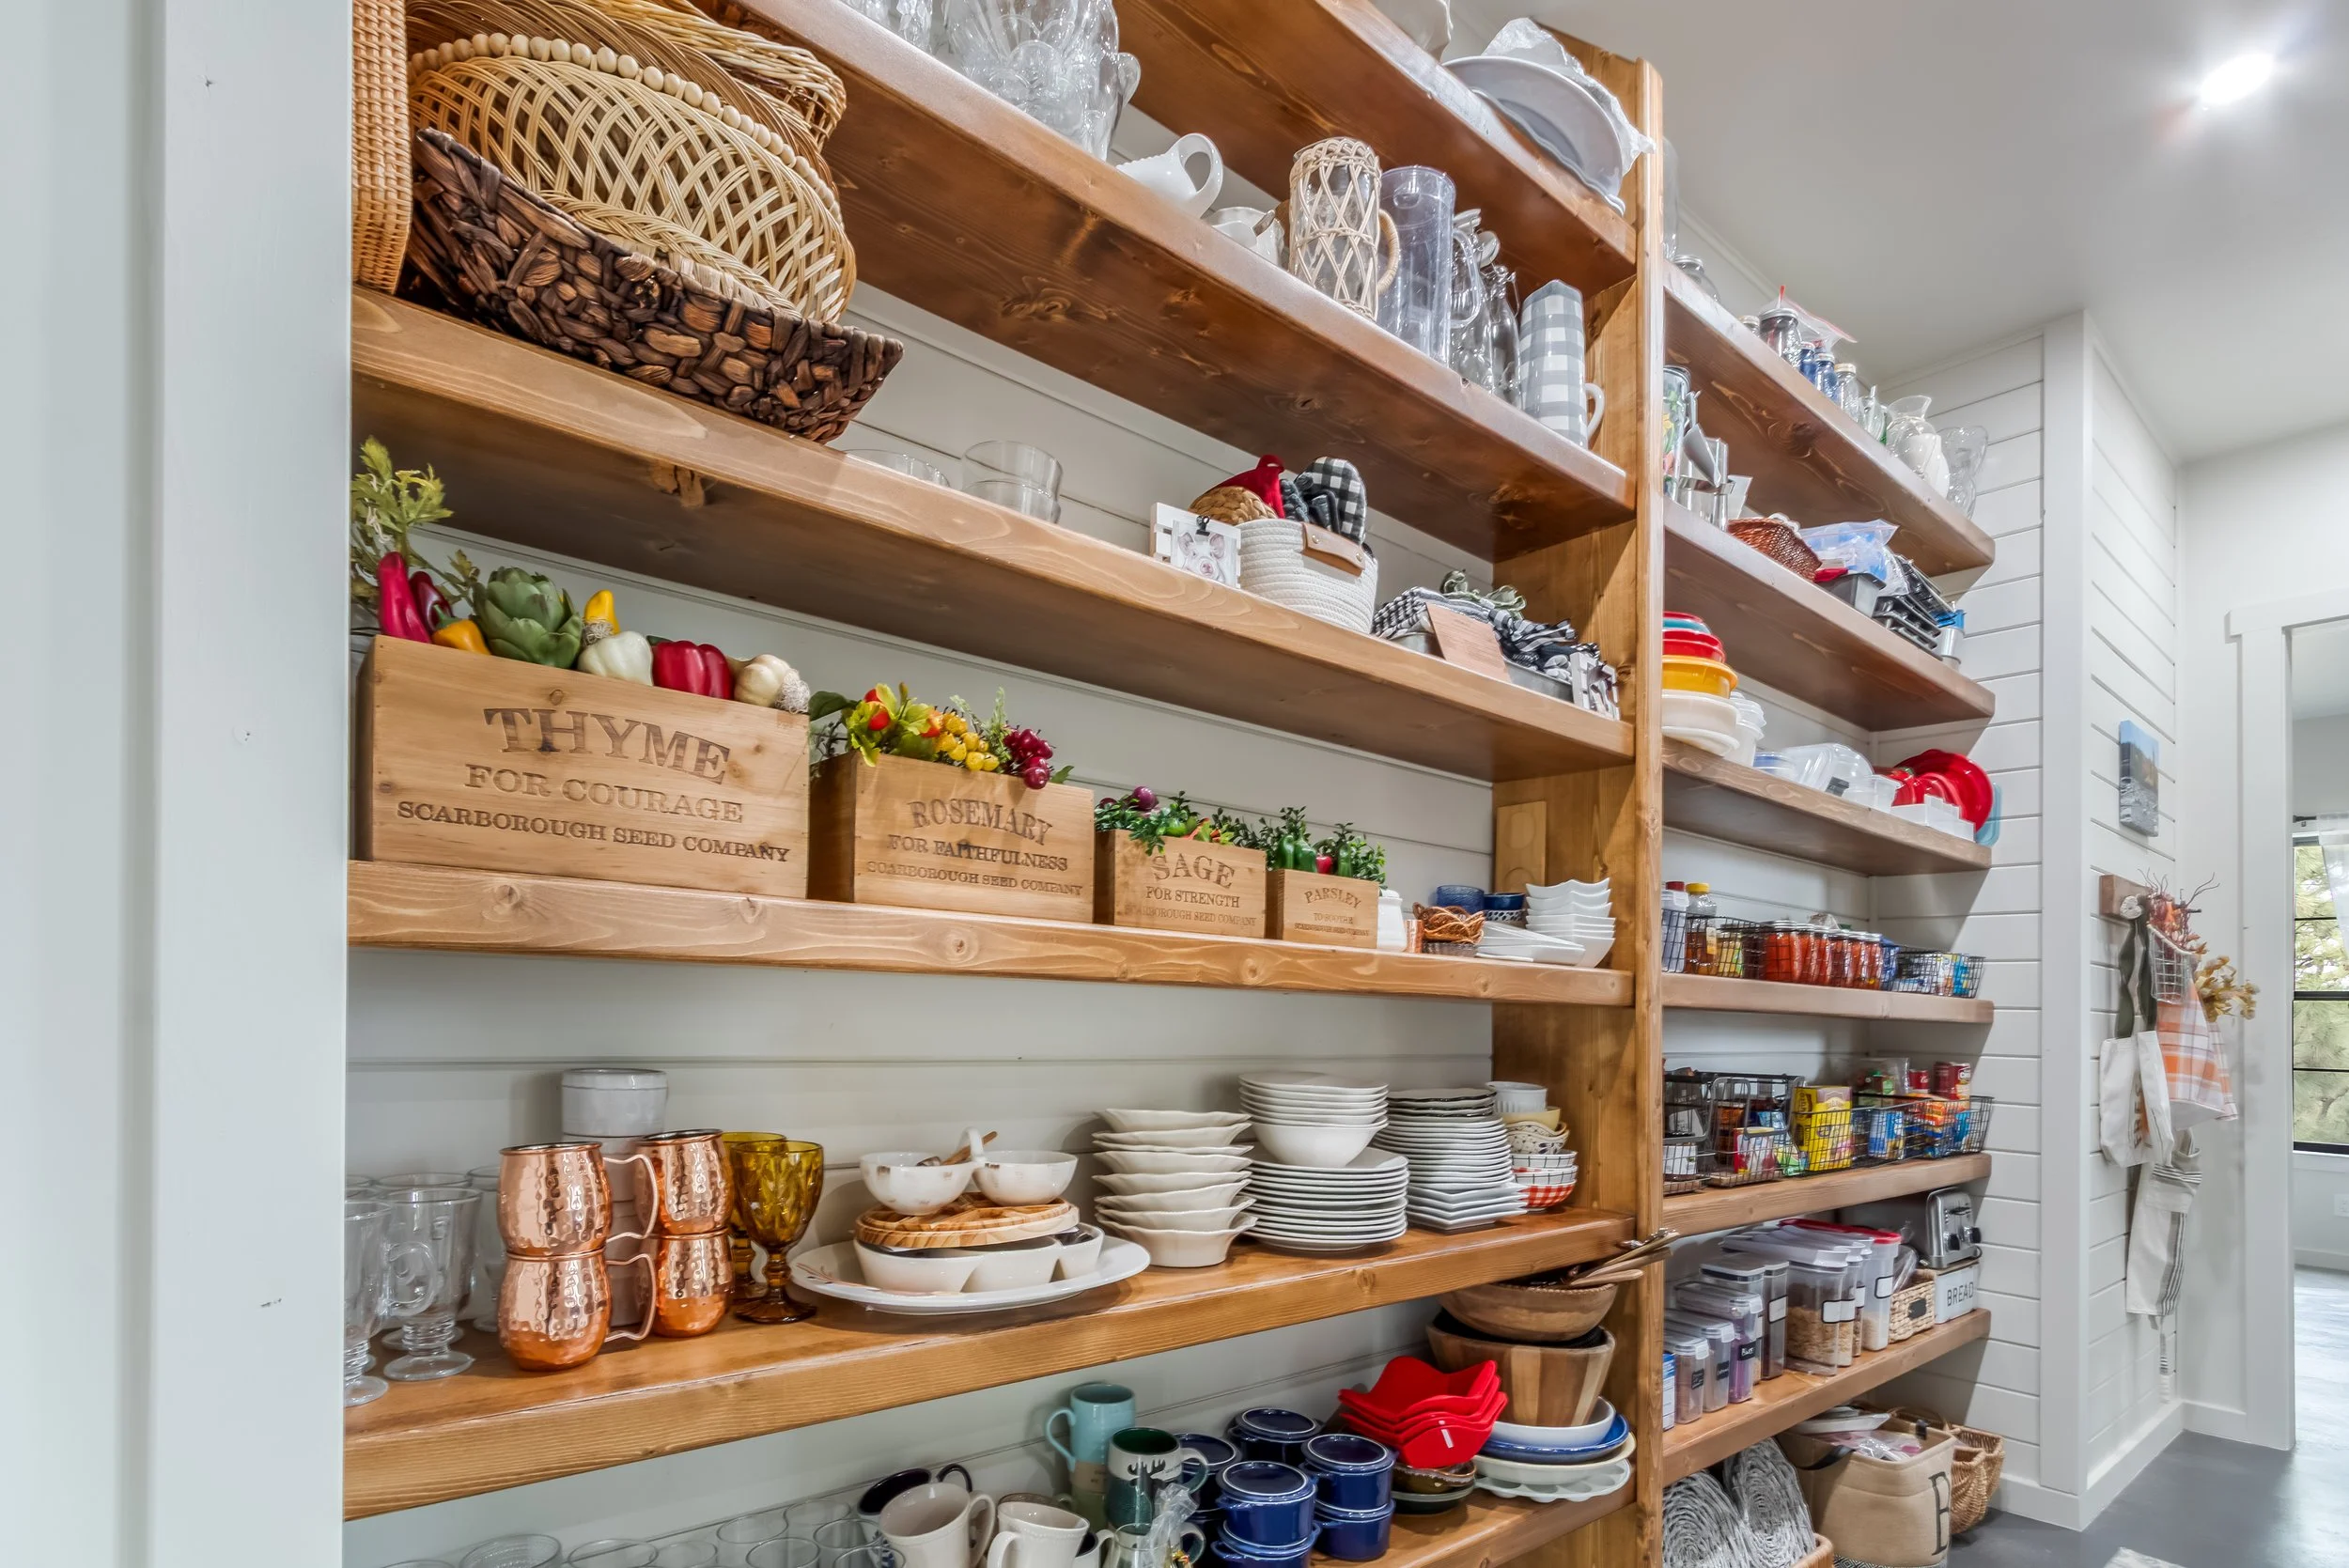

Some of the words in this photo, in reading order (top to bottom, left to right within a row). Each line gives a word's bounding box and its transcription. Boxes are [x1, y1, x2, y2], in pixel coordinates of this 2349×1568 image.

[484, 707, 730, 785] THYME
[465, 763, 552, 798] FOR
[563, 778, 743, 824] COURAGE
[397, 801, 606, 841] SCARBOROUGH
[613, 828, 676, 849] SEED
[682, 836, 791, 862] COMPANY
[907, 798, 1053, 846] ROSEMARY
[887, 834, 928, 854] FOR
[932, 840, 1068, 872] FAITHFULNESS
[1151, 852, 1236, 890] SAGE
[867, 861, 979, 884] SCARBOROUGH
[982, 875, 1018, 889] SEED
[1021, 878, 1083, 896] COMPANY
[1145, 886, 1173, 901] FOR
[1174, 890, 1240, 908] STRENGTH
[1304, 887, 1361, 908] PARSLEY
[1194, 911, 1216, 923] SEED
[1947, 1281, 1974, 1307] BREAD
